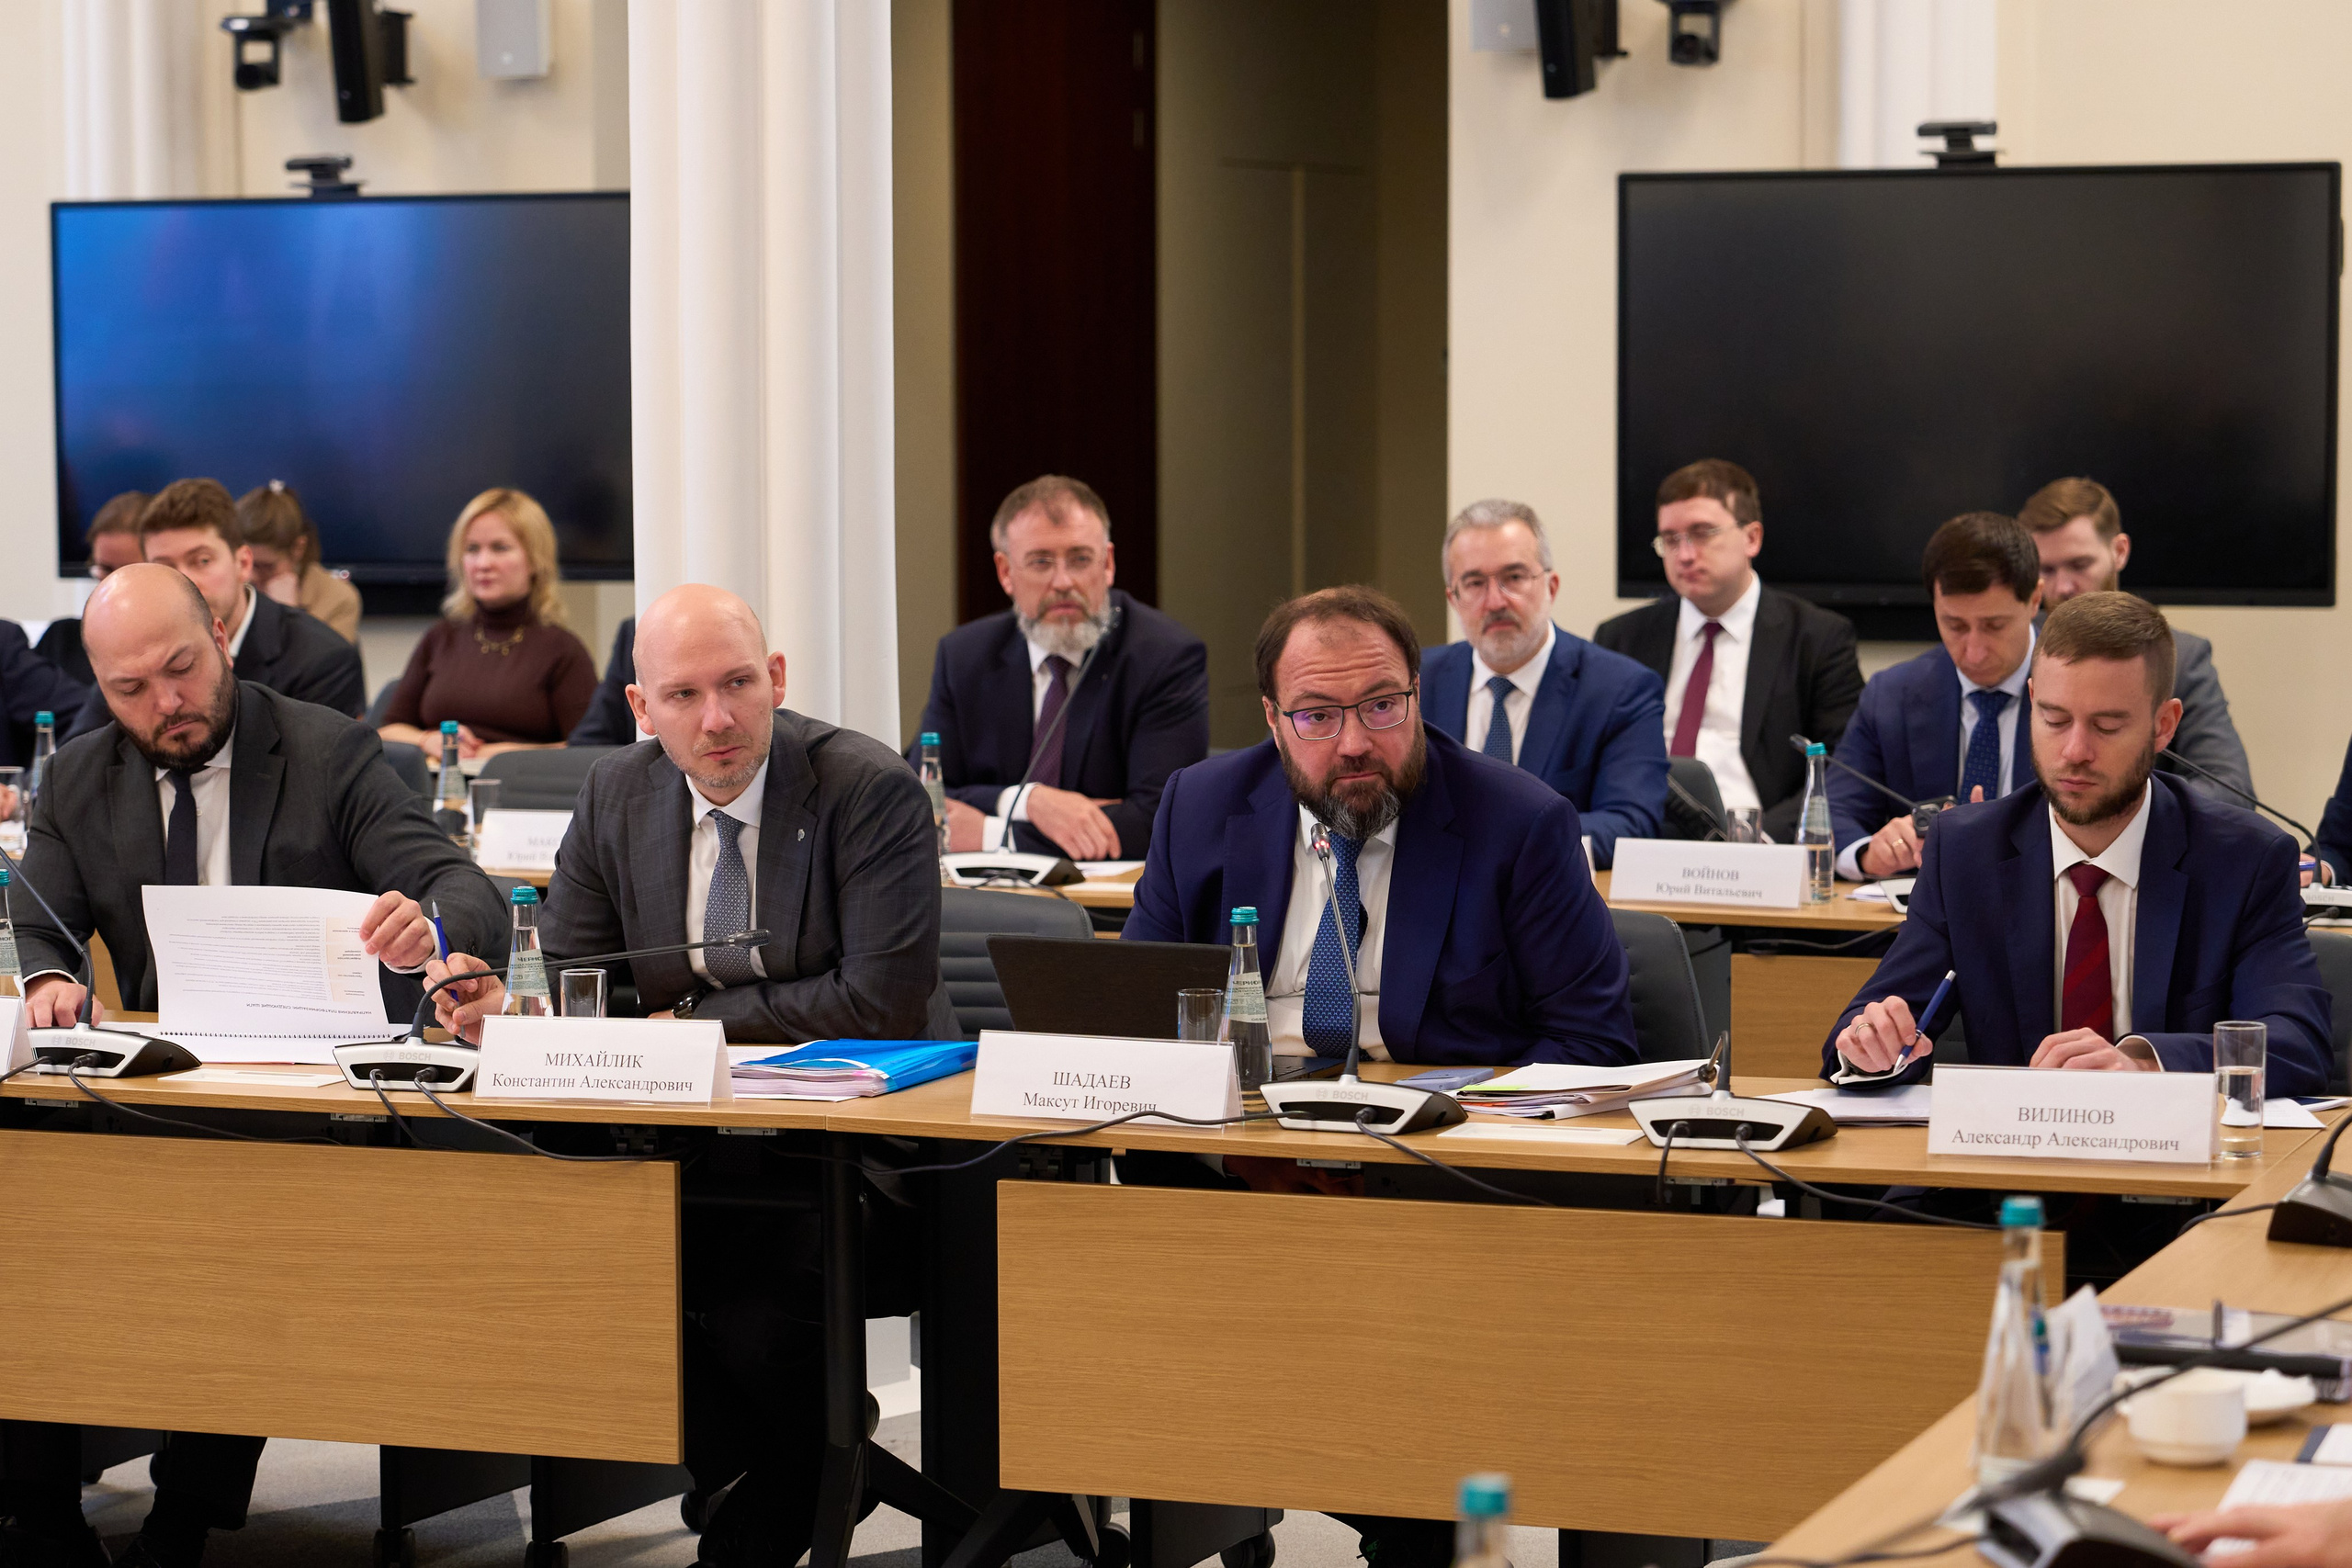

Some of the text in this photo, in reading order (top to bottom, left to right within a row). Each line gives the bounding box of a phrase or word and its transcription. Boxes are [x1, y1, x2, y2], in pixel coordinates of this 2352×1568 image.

[1681, 865, 1740, 881] ВОЙНОВ
[1655, 882, 1763, 898] Юрий Витальевич
[65, 1037, 96, 1046] BOSCH
[399, 1052, 431, 1061] BOSCH
[545, 1050, 644, 1068] МИХАЙЛИК
[492, 1073, 694, 1094] Константин Александрович
[1053, 1071, 1131, 1089] ШАДАЕВ
[1332, 1090, 1369, 1100] BOSCH
[1023, 1092, 1157, 1115] Максут Игоревич
[1706, 1107, 1745, 1117] BOSCH
[2018, 1107, 2115, 1124] ВИЛИНОВ
[1951, 1129, 2179, 1153] Александр Александрович
